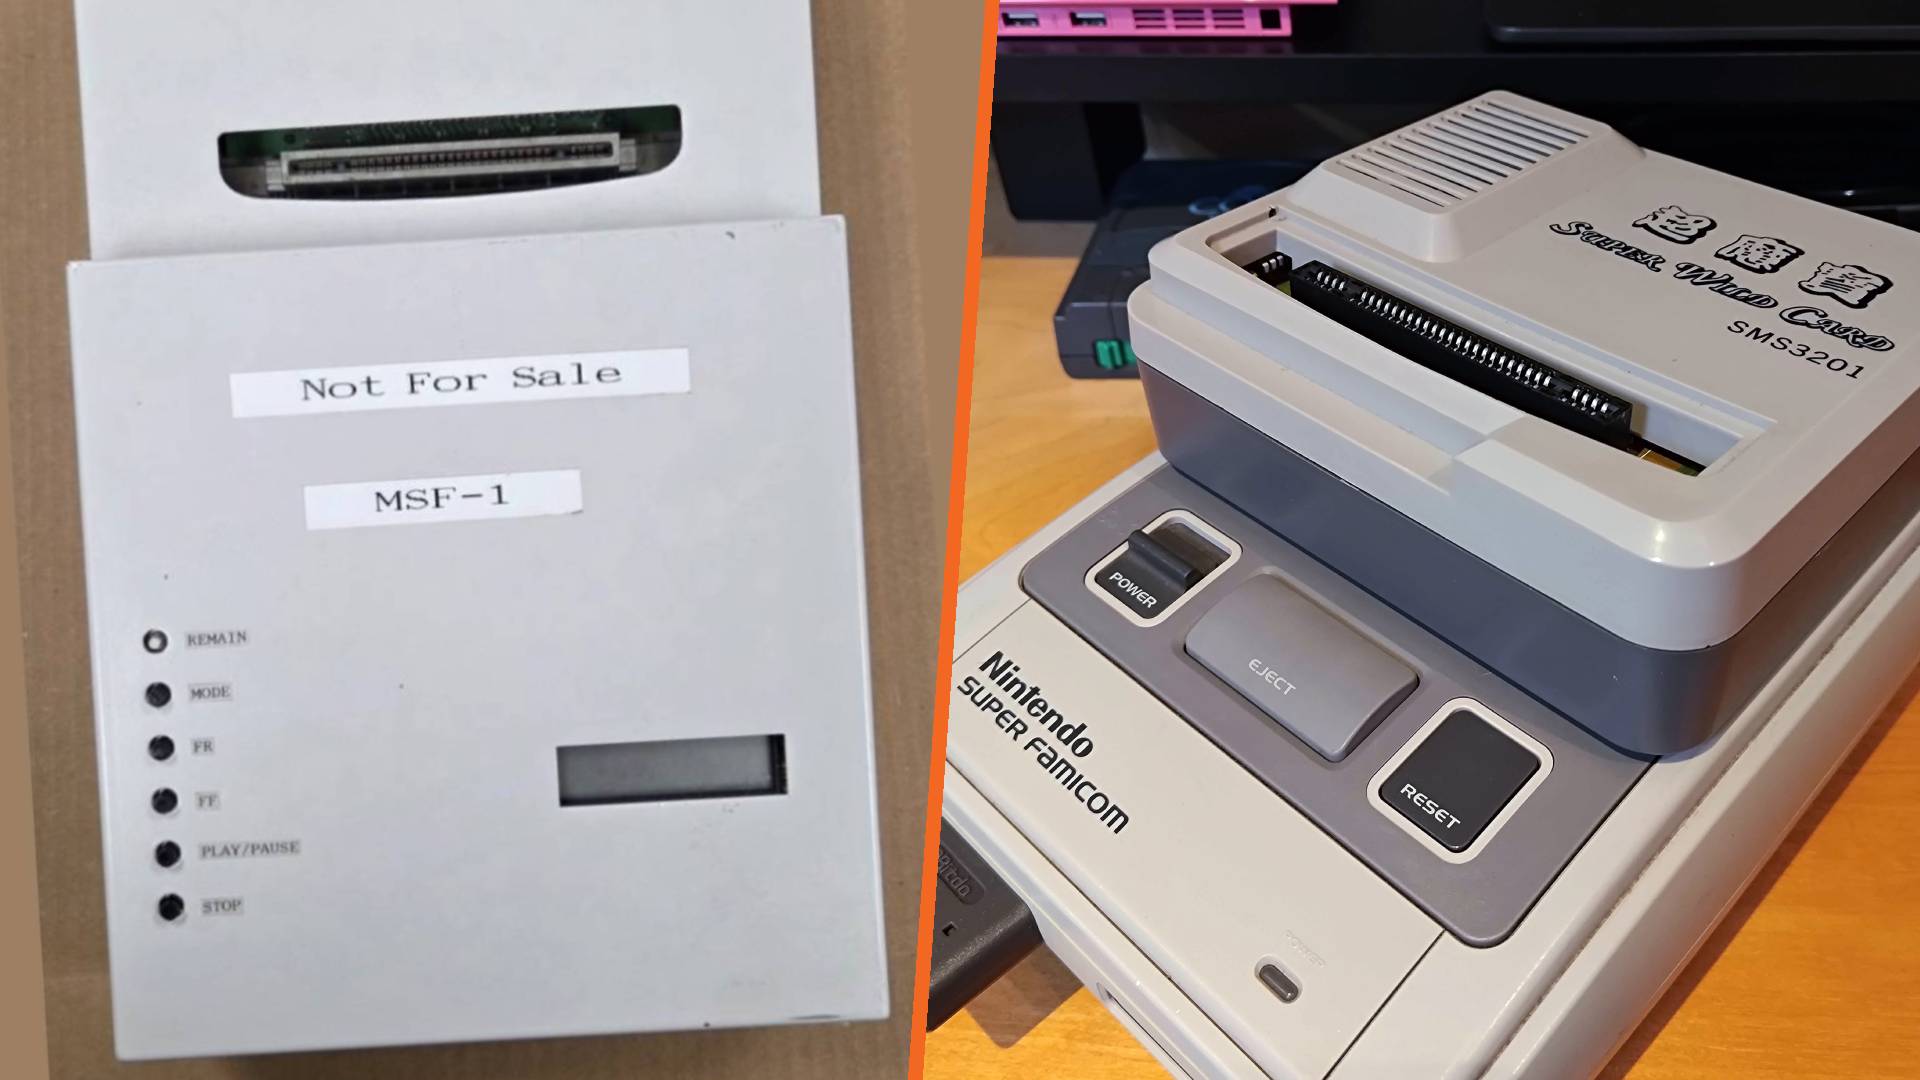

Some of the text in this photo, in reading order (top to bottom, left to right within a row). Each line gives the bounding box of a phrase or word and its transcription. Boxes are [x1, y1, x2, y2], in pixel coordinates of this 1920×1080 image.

[1727, 320, 1865, 379] SMS3201
[301, 362, 623, 401] Not For Sale
[374, 484, 510, 513] MSF-1
[1109, 572, 1158, 609] POWER
[187, 630, 248, 647] REMAIN
[190, 685, 231, 700] MODE
[1248, 658, 1297, 696] EJECT
[957, 675, 1029, 741] SUPER
[978, 650, 1094, 758] Nintendo
[193, 740, 214, 754] FR
[198, 794, 218, 808] FF
[1400, 783, 1461, 829] RESET
[201, 841, 300, 859] PLAY/PAUSE
[202, 899, 242, 914] STOP
